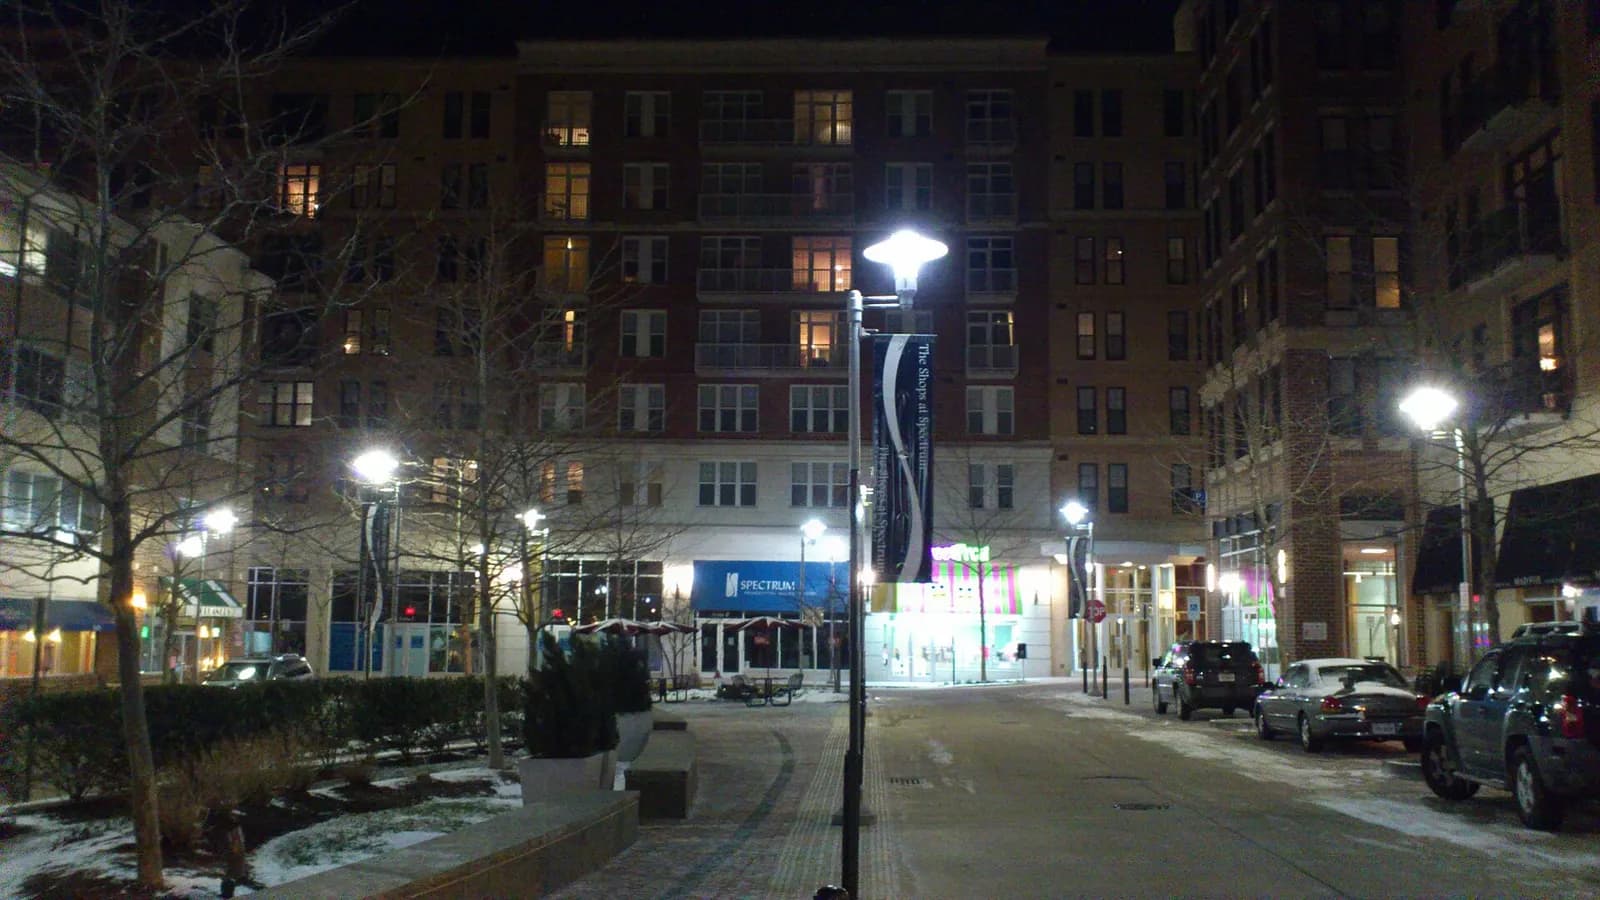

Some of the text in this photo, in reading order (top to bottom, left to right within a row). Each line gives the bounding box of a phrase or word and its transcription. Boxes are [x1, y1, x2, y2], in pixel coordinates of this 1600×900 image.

[915, 343, 930, 470] The Shops at Spectrum
[740, 580, 796, 591] SPECTRUM
[1087, 606, 1105, 616] OP
